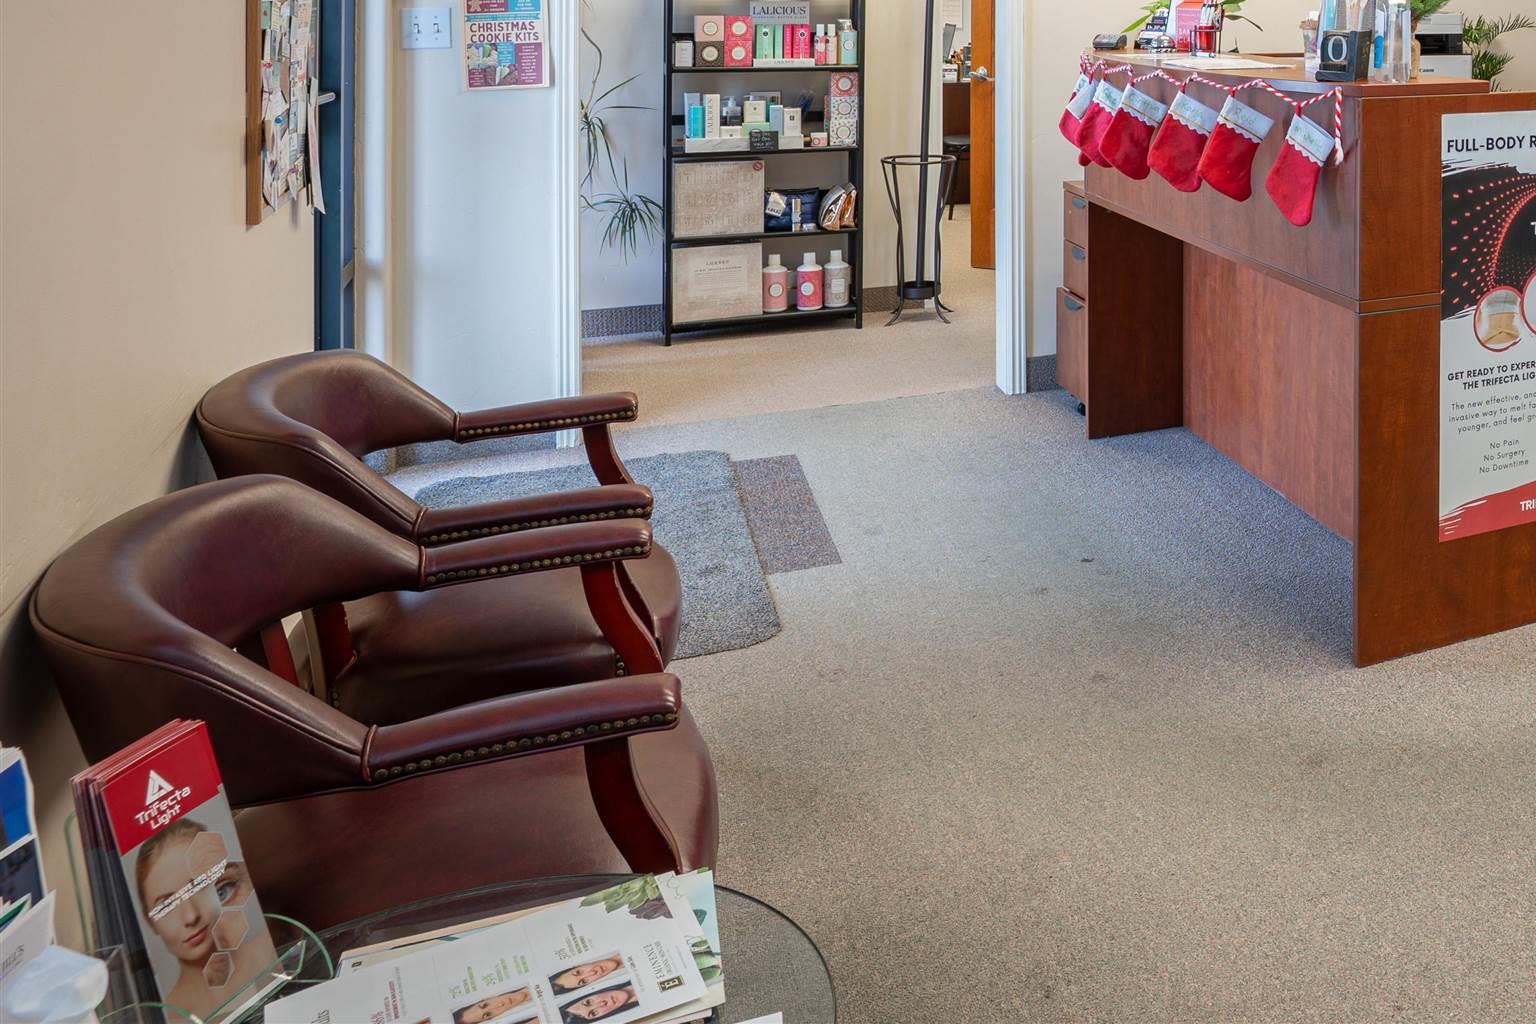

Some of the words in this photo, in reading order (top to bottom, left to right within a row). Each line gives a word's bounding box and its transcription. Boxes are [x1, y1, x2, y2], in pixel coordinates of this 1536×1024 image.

[752, 6, 806, 15] LALICIOUS
[470, 22, 535, 32] CHRISTMAS
[470, 33, 512, 42] COOKIE
[515, 32, 539, 42] KITS
[1447, 136, 1525, 153] FULL-BODY
[1447, 371, 1464, 381] GET
[1466, 366, 1495, 379] READY
[1497, 364, 1508, 374] TO
[1463, 379, 1479, 390] THE
[1481, 373, 1520, 388] TRIFECTA
[1490, 441, 1501, 449] No
[1503, 438, 1520, 447] Pain
[1483, 453, 1495, 462] No
[1497, 448, 1526, 460] Surgery
[1479, 465, 1490, 474] No
[1493, 458, 1529, 472] Downtime
[135, 784, 192, 826] Trifecta
[149, 805, 182, 830] Light
